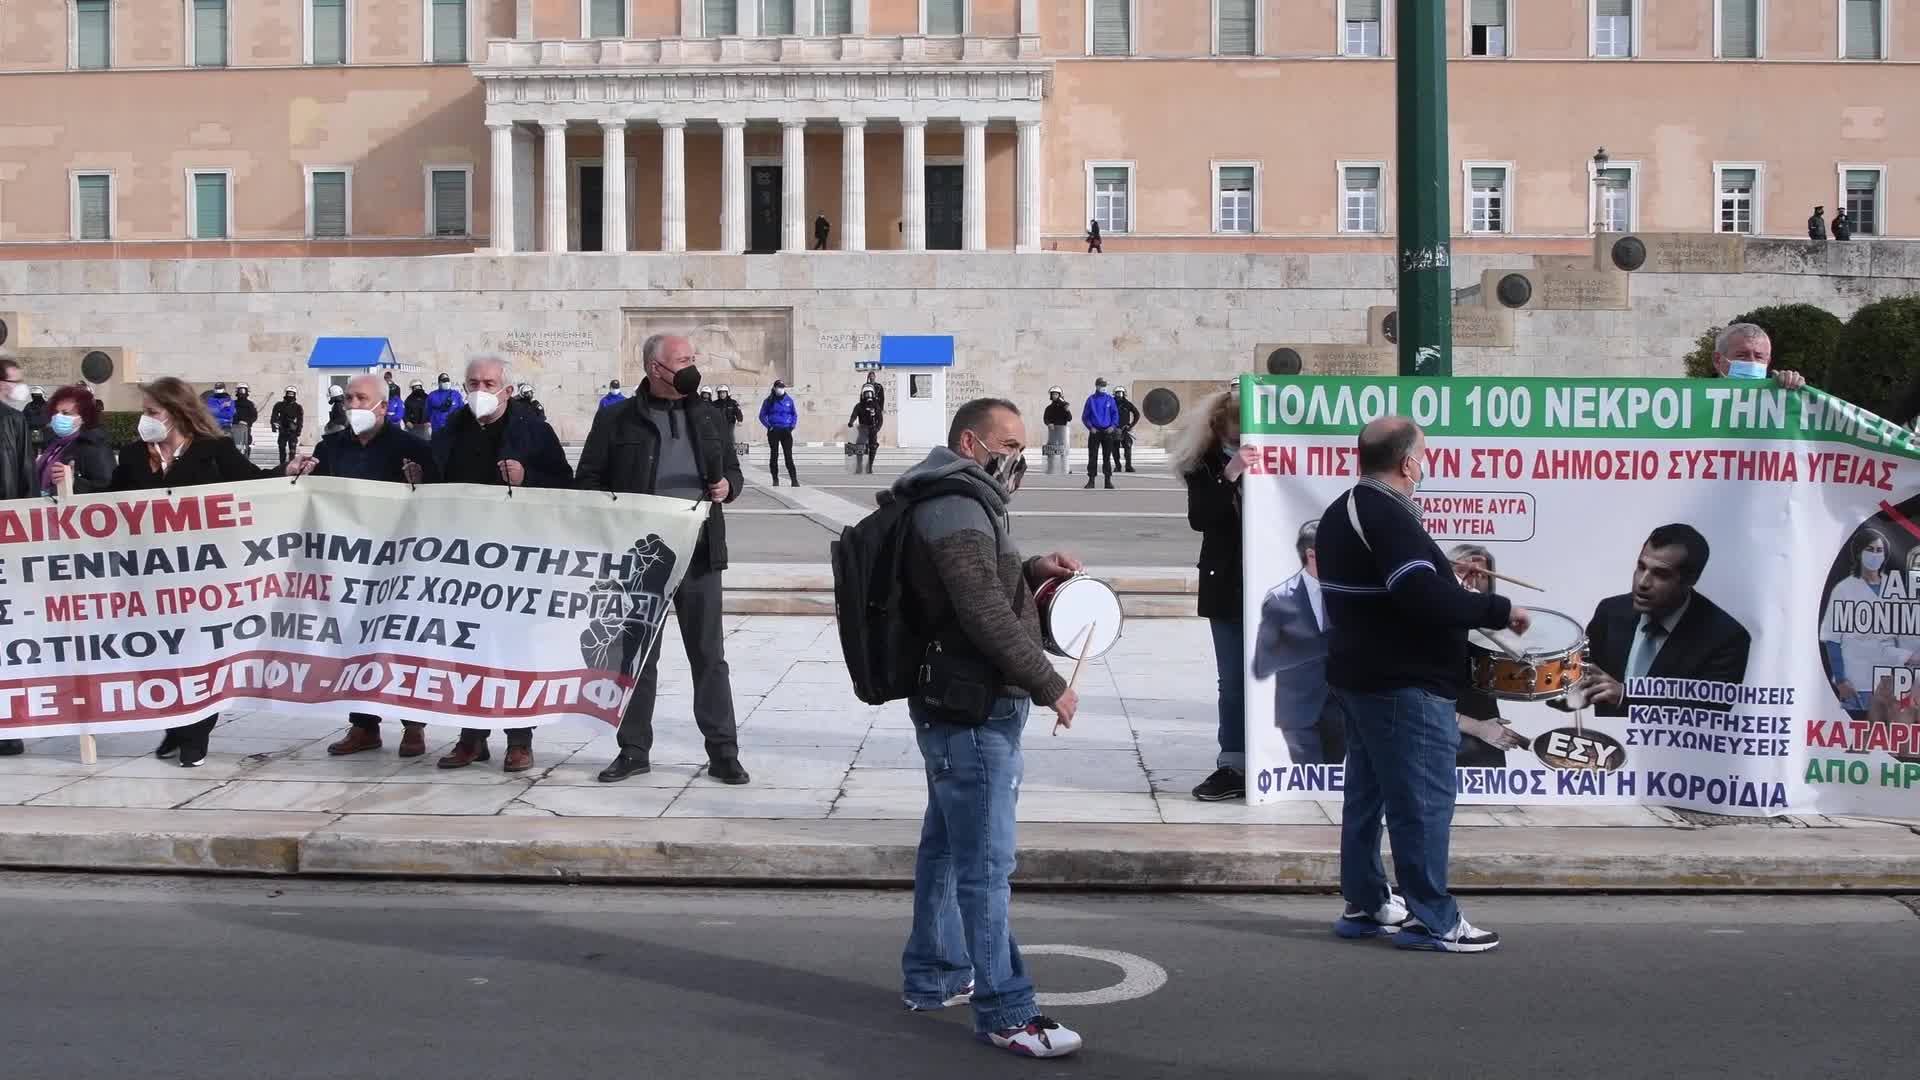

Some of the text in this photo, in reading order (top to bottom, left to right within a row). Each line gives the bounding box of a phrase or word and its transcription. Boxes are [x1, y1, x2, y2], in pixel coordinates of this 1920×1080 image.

[1253, 385, 1397, 425] ΠΟΛΛΟΙ
[1411, 386, 1449, 427] ΟΙ
[1465, 386, 1532, 428] 100
[1545, 387, 1692, 429] ΝΕΚΡΟΙ
[1706, 388, 1786, 429] ΤΗΝ
[1471, 448, 1523, 479] ΣΤΟ
[1532, 449, 1659, 480] ΔΗΜΟΣΙΟ
[1668, 450, 1798, 482] ΣΥΣΤΗΜΑ
[1807, 452, 1898, 491] ΥΓΕΙΑΣ
[0, 493, 253, 544] ΔΙΚΟΥΜΕ:
[1488, 499, 1526, 514] ΑΥΓΑ
[1453, 519, 1495, 534] ΥΓΕΙΑ
[22, 544, 227, 583] ΓΕΝΝΑΙΑ
[242, 532, 634, 581] ΧΡΗΜΑΤΟΔΟΤΗΣΗ
[45, 591, 147, 623] ΜΕΤΡΑ
[155, 571, 333, 615] ΠΡΟΣΤΑΣΙΑΣ
[340, 575, 415, 606] ΣΤΟΥΣ
[417, 576, 542, 615] ΧΩΡΟΥΣ
[0, 611, 481, 666] ΩΤΙΚΟΥ ΤΟΜΕΑ ΥΓΕΙΑΣ
[101, 658, 311, 713] ΠΟΕ/ΠΦΥ
[1628, 678, 1795, 705] ΙΔΙΩΤΙΚΟΠΟΙΗΣΕΙΣ
[1630, 706, 1791, 734] ΚΑΤΑΡΓΗΣΕΙΣ
[1547, 731, 1617, 767] ΕΣΥ
[1626, 729, 1790, 756] ΣΥΓΧΩΝΕΥΣΕΙΣ
[1557, 769, 1605, 795] ΚΑΙ
[1617, 771, 1635, 796] Η
[1647, 771, 1790, 808] ΚΟΡΟΪΔΙΑ
[1804, 758, 1869, 785] ΑΠΟ
